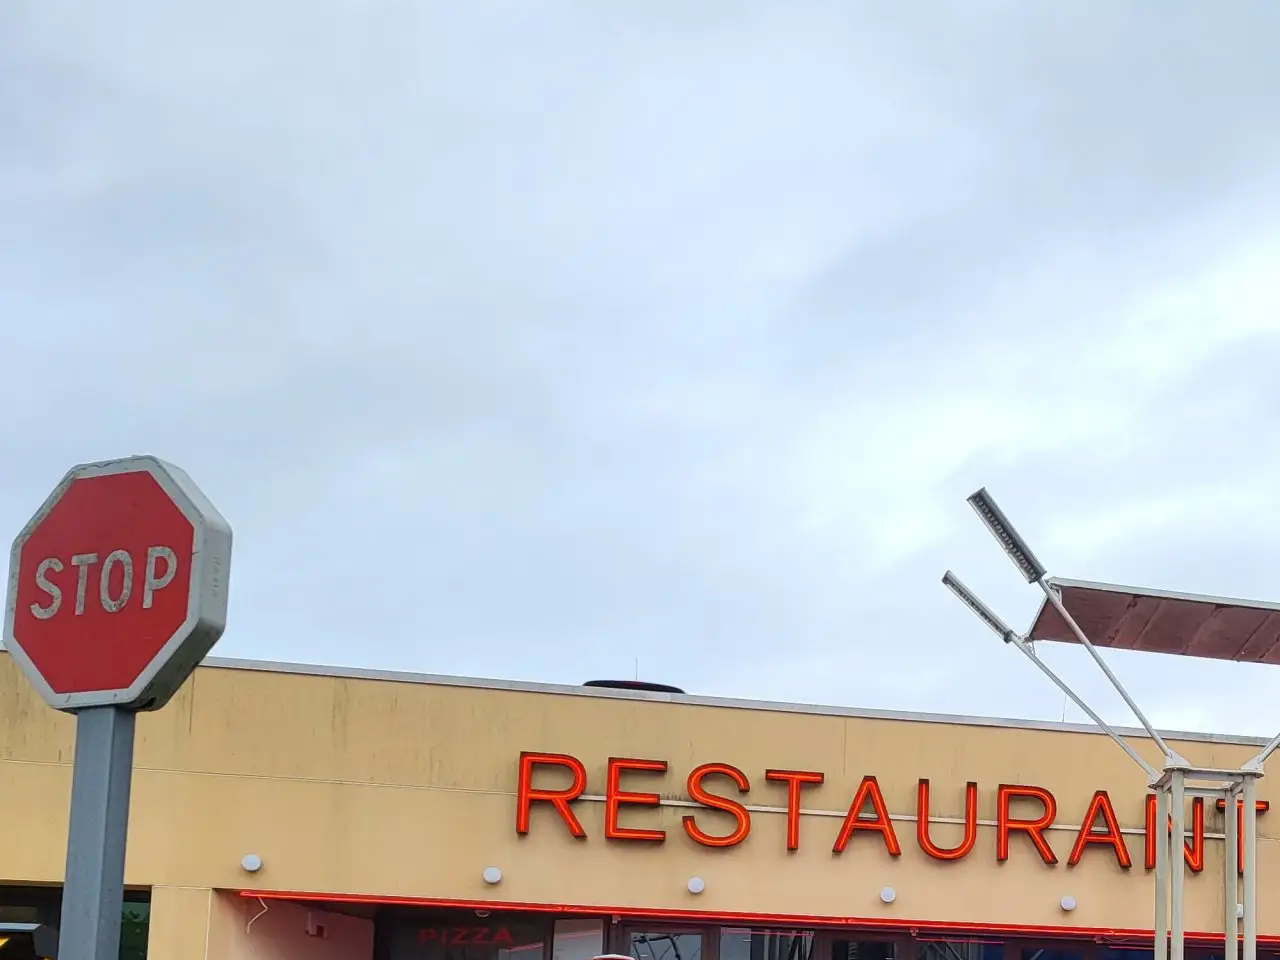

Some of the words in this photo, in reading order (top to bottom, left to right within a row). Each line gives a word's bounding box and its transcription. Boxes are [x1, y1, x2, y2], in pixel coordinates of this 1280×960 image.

[29, 545, 178, 620] STOP
[515, 750, 1269, 877] RESTAURANT
[418, 926, 514, 946] PIZZA
